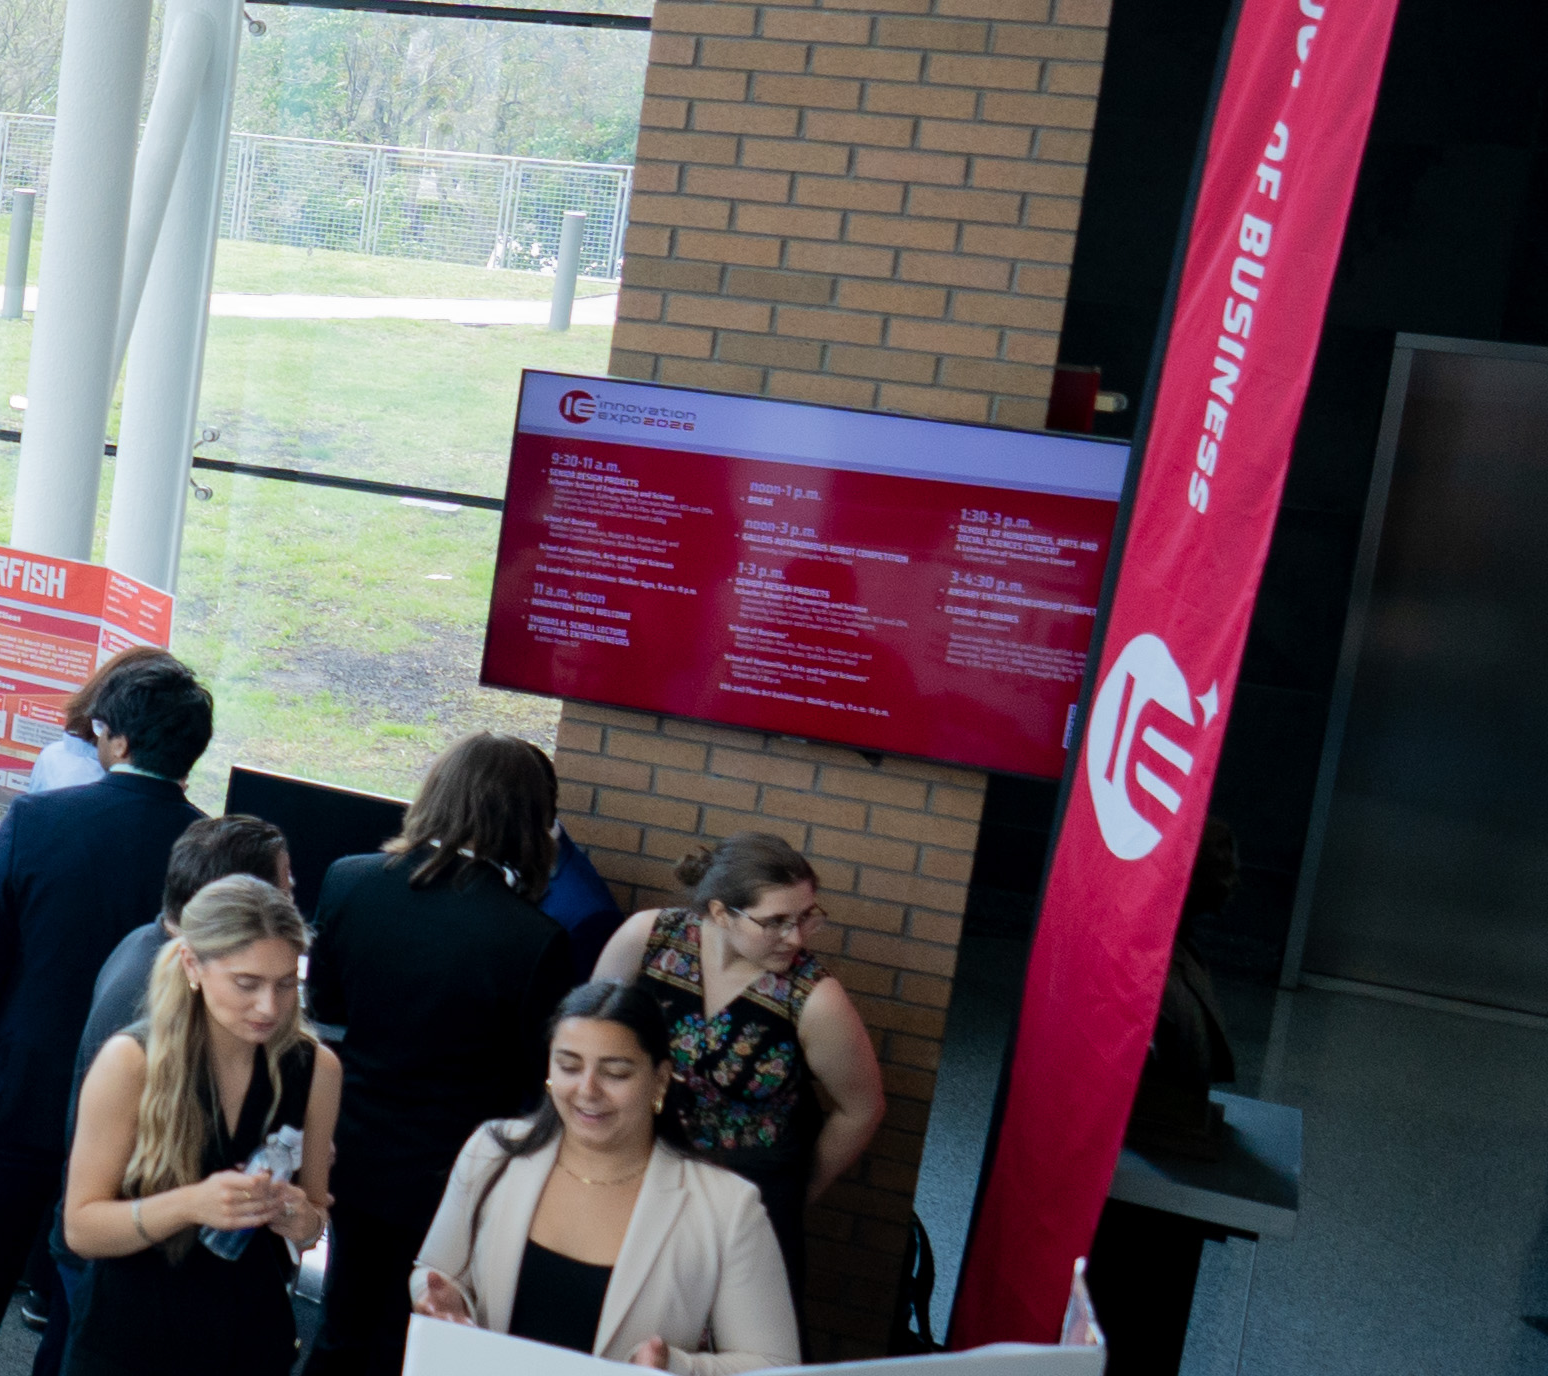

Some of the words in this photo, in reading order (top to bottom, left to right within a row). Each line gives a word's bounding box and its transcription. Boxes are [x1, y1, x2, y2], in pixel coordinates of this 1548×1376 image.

[1186, 214, 1276, 516] BUSINESS
[598, 411, 695, 431] expo2026
[599, 400, 697, 421] innovation
